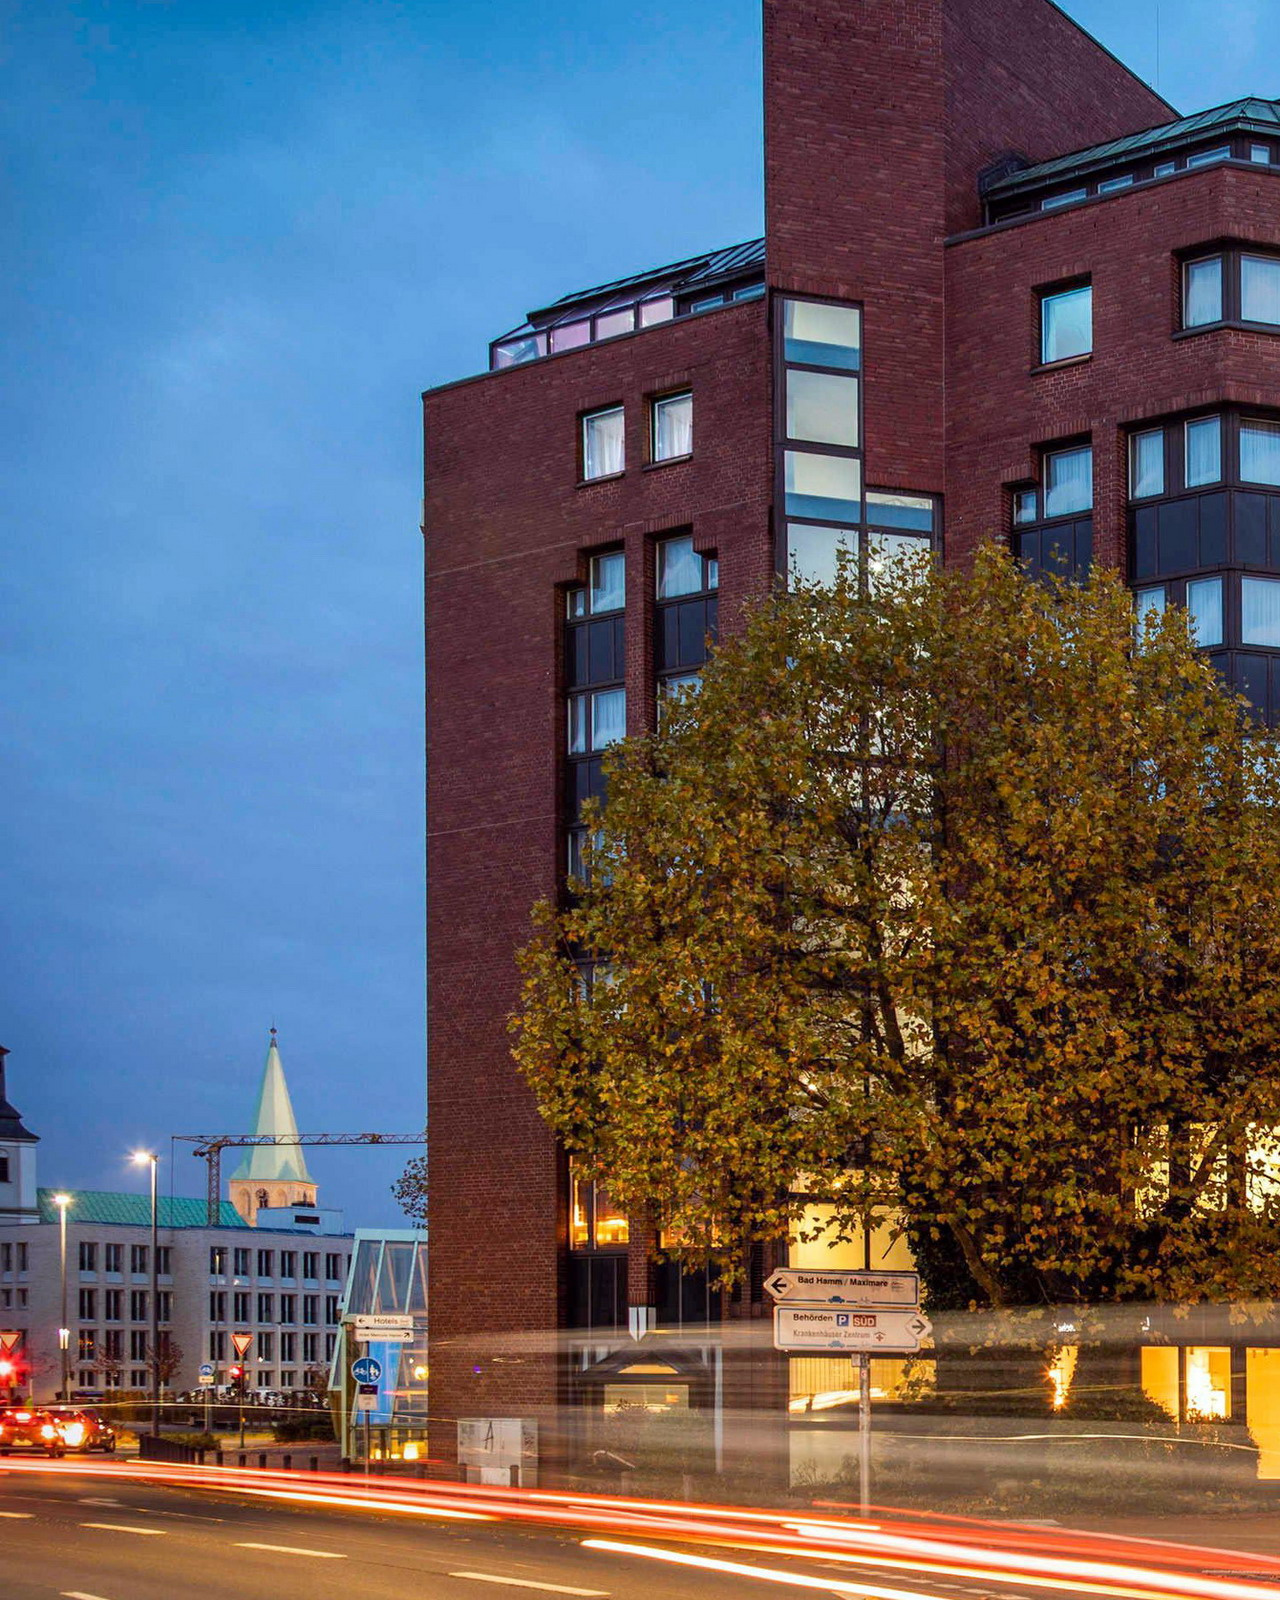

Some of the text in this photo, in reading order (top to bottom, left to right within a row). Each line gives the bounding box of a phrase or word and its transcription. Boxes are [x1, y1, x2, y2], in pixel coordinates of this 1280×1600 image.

[798, 1276, 814, 1284] Bad
[816, 1277, 843, 1285] Hamm
[850, 1278, 888, 1287] Maximare
[793, 1313, 833, 1321] Behörden
[853, 1315, 875, 1326] SÜD
[793, 1330, 841, 1338] Krankenhäuser
